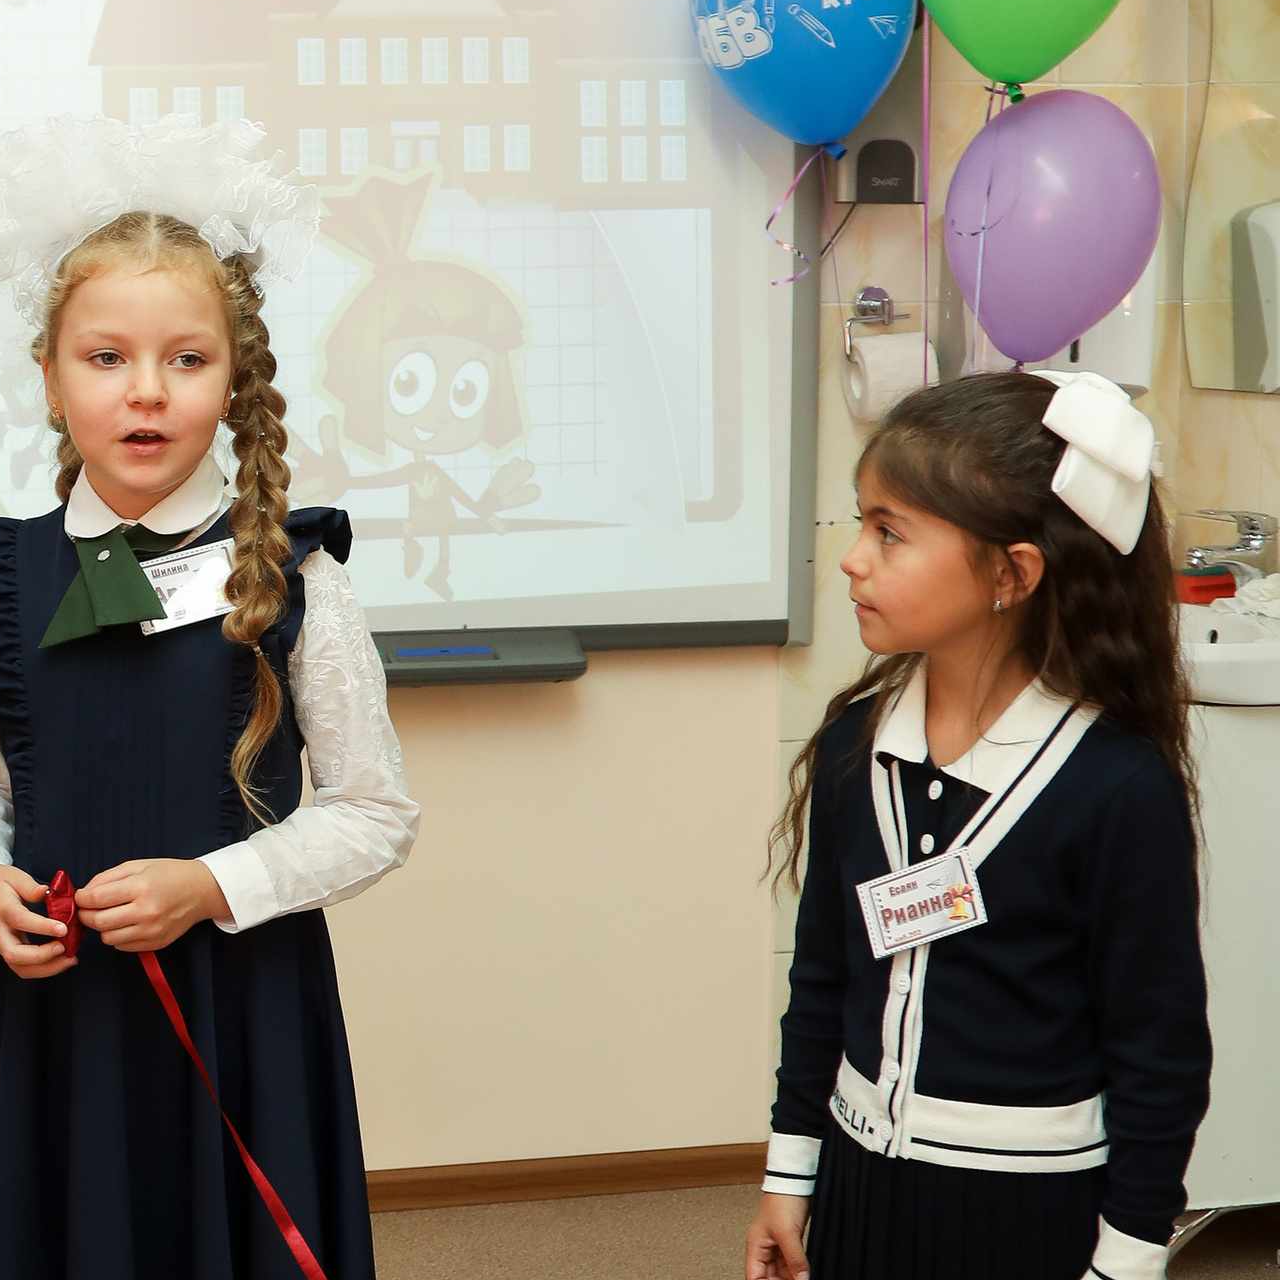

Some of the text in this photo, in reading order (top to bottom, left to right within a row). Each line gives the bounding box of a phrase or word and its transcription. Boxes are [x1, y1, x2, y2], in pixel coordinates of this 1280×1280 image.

[697, 4, 774, 70] АБВ
[151, 563, 189, 579] Шилина
[888, 879, 919, 897] Есаян
[880, 891, 955, 930] Рианна
